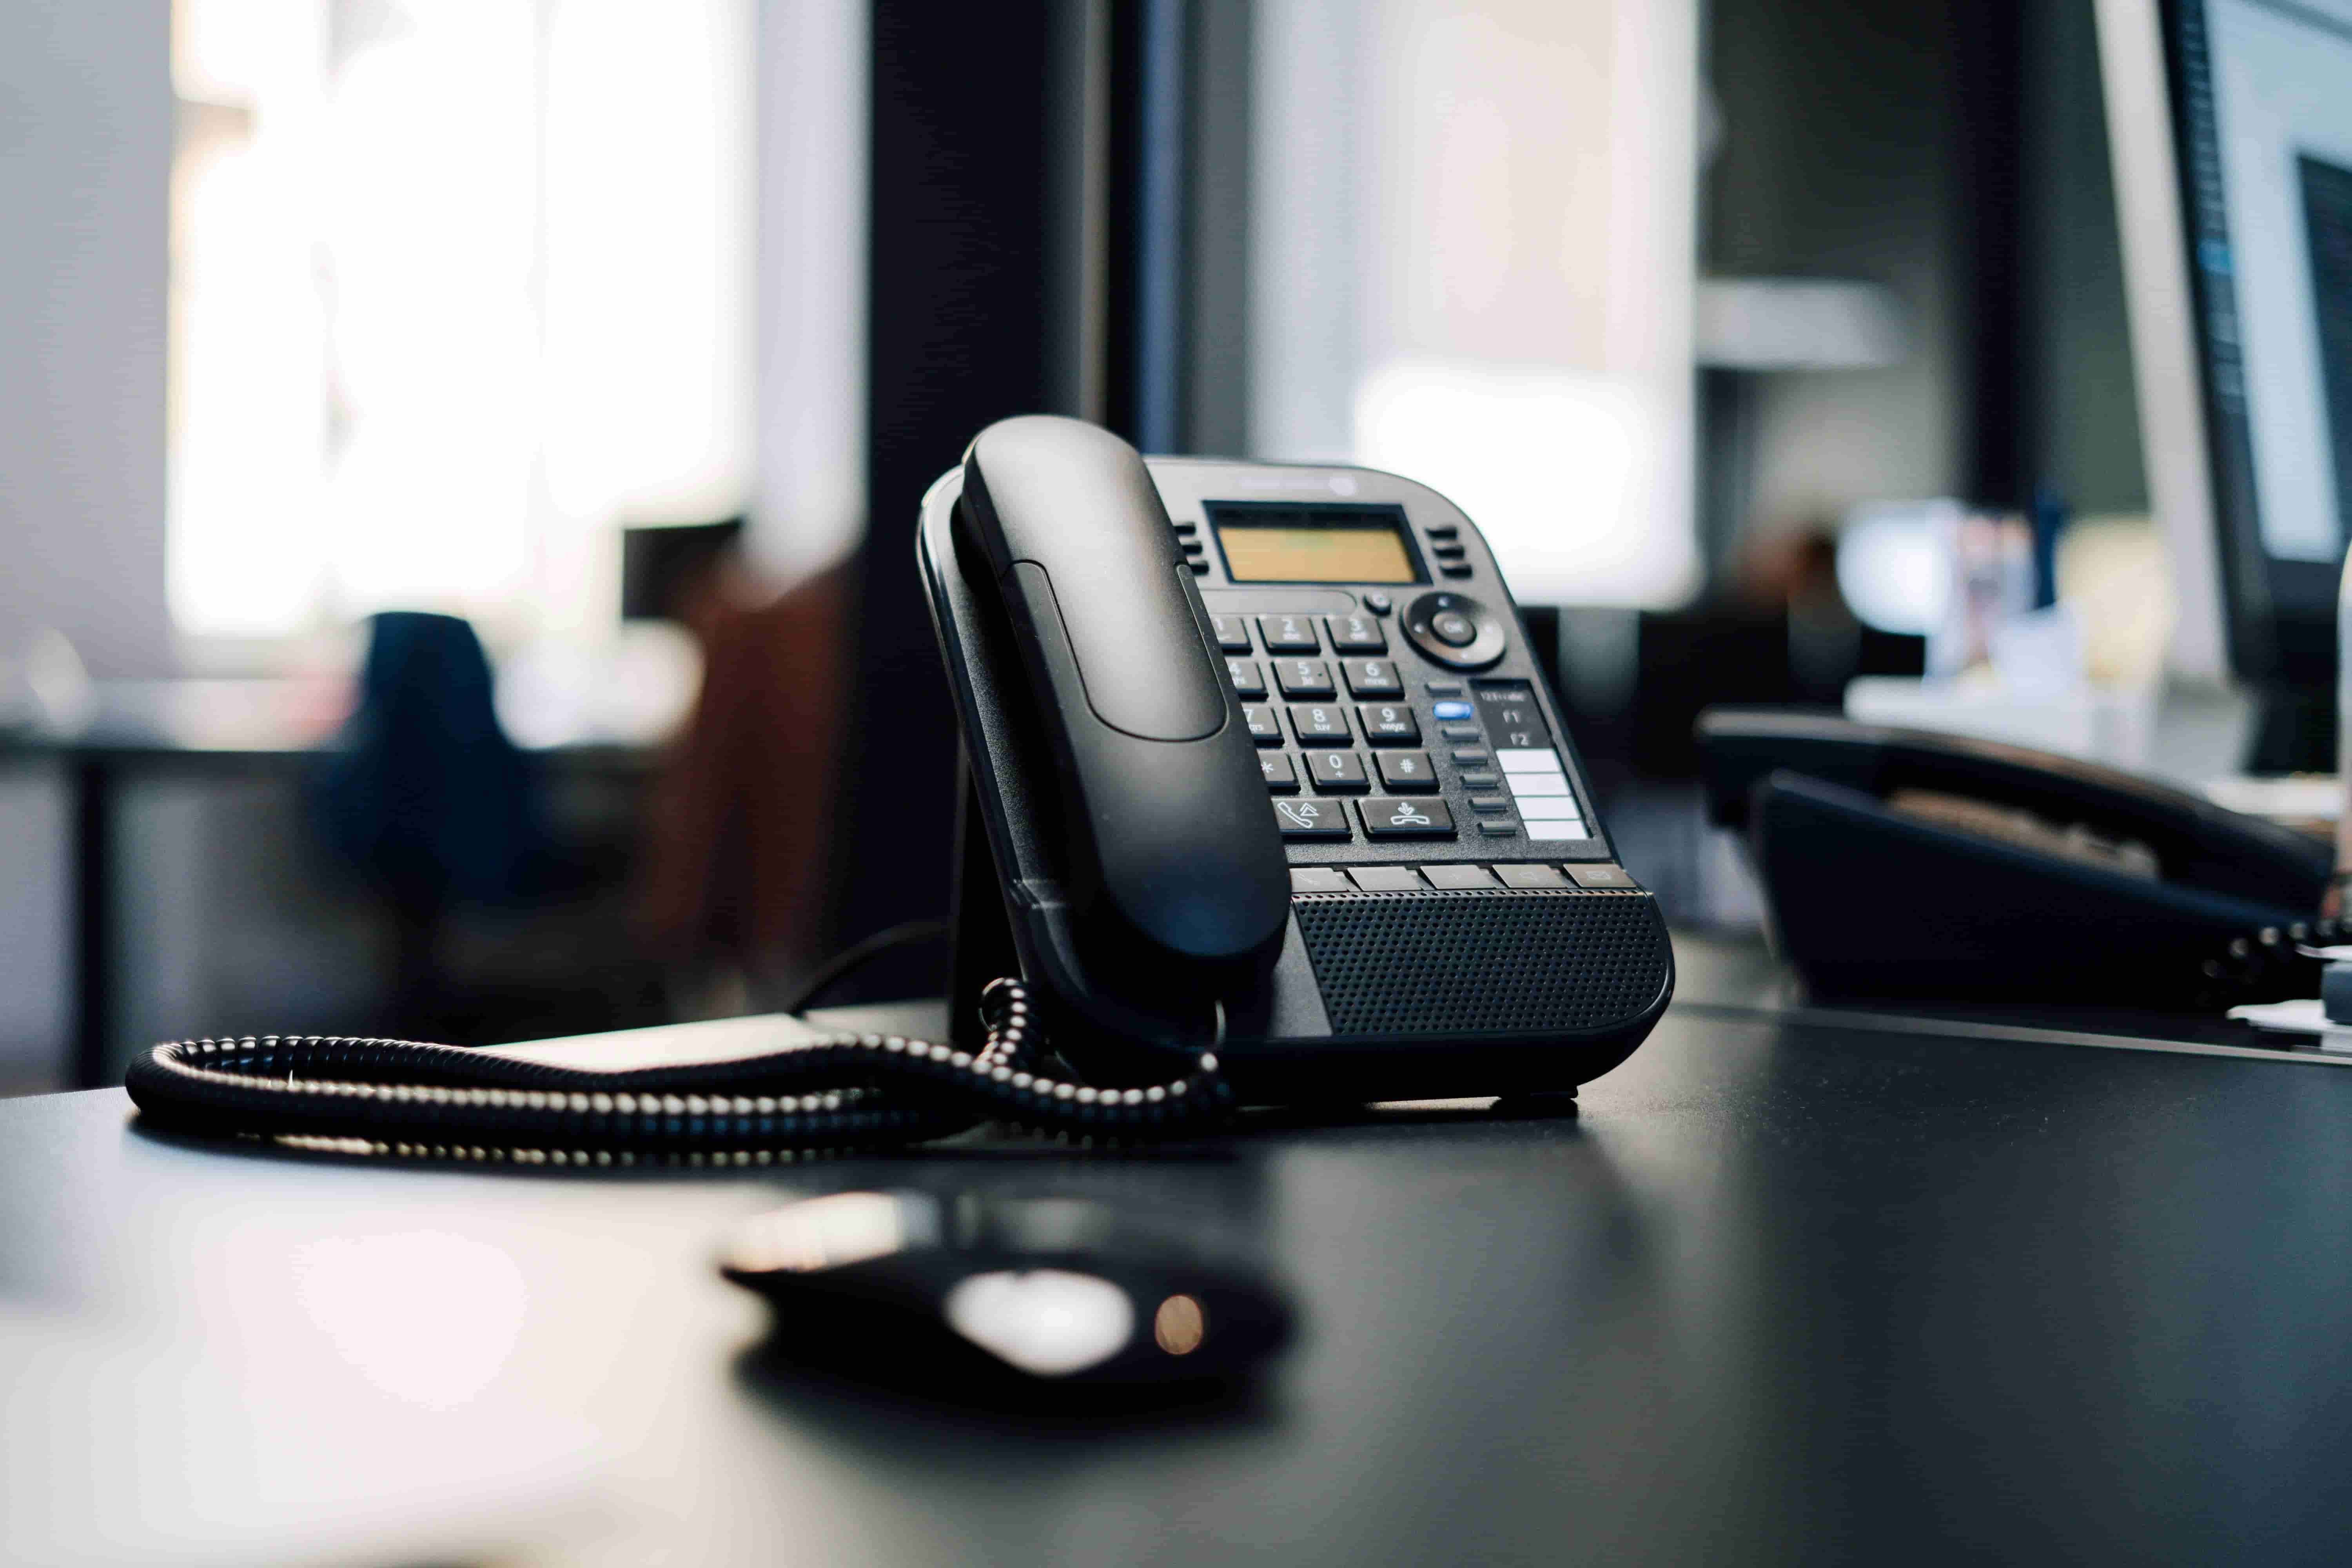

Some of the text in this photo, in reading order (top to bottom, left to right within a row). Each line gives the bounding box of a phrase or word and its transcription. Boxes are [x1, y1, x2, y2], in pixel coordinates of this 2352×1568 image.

[1282, 617, 1296, 632] 2
[1348, 617, 1362, 632] 3
[1297, 662, 1310, 675] 5
[1365, 662, 1380, 677] 6
[1313, 708, 1326, 722] 8
[1381, 707, 1396, 722] 9
[1503, 711, 1519, 723] F1
[1379, 722, 1406, 732] wxyz
[1510, 733, 1529, 746] F2
[1329, 755, 1342, 769] 0
